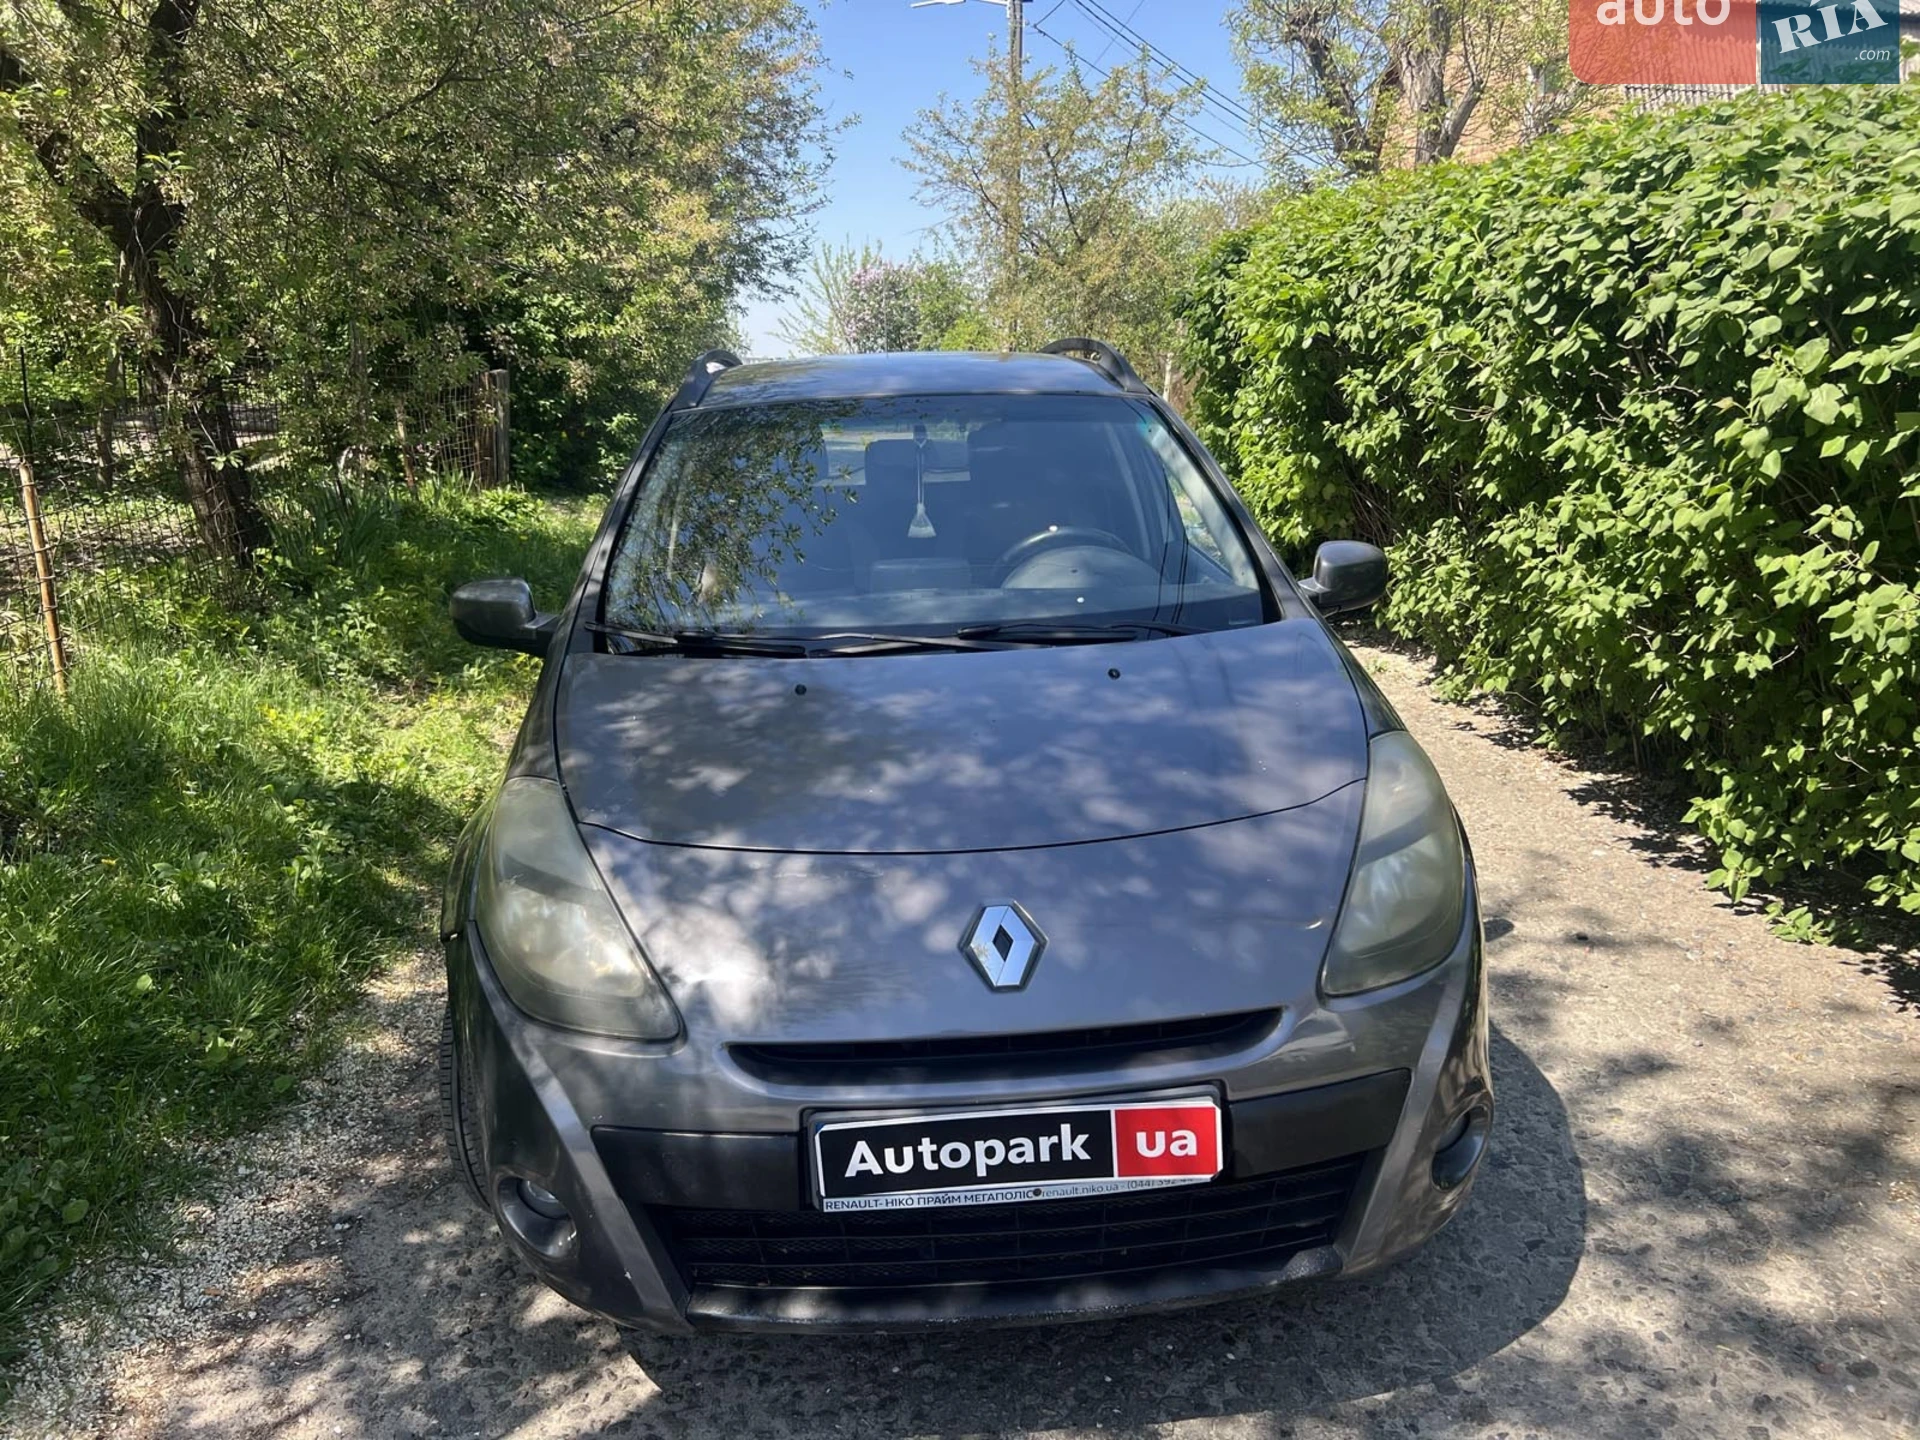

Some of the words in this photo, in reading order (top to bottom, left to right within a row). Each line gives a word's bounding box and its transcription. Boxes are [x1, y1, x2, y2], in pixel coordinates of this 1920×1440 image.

[844, 1122, 1091, 1178] Autopark
[1135, 1129, 1198, 1158] ua
[917, 1193, 961, 1206] ПРАЙМ
[964, 1189, 1034, 1203] МЕГАПОЛІС
[1042, 1184, 1119, 1198] renault.niko.ua
